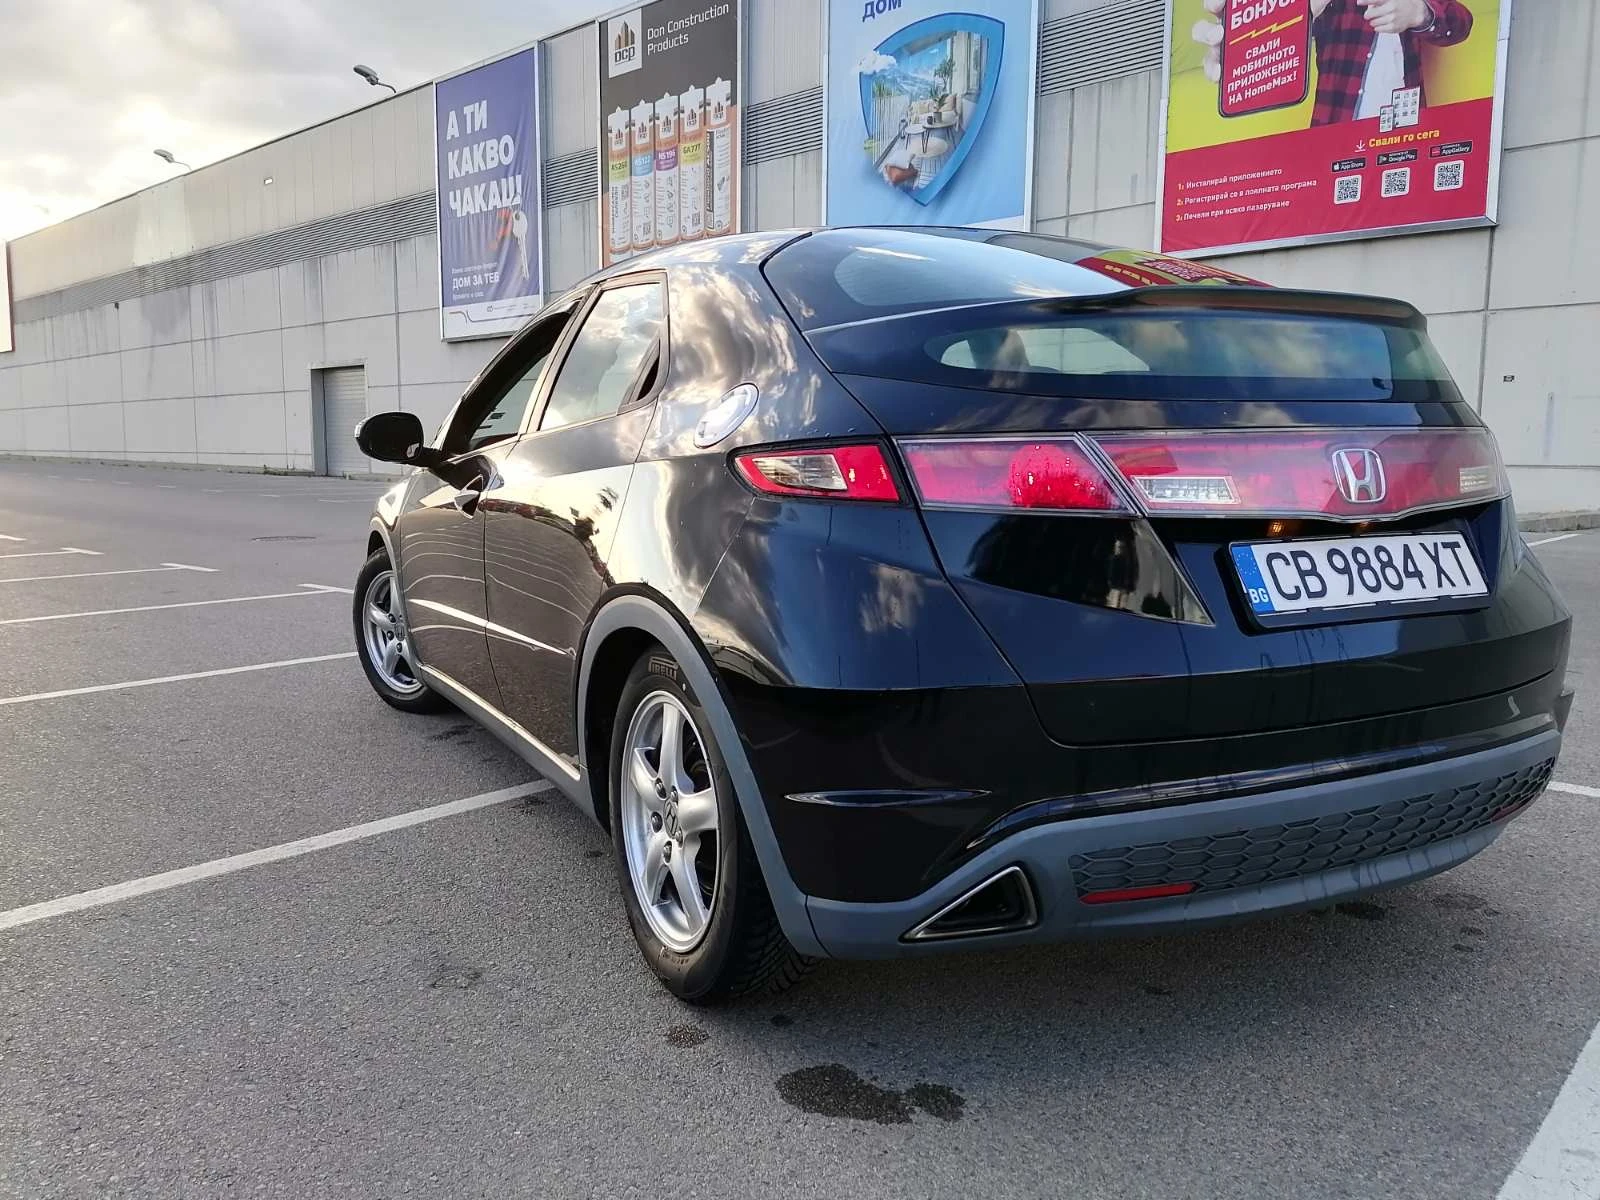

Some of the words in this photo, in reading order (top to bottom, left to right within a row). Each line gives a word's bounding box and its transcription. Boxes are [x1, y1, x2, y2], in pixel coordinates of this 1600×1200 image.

[647, 26, 665, 40] Don
[667, 4, 729, 33] Construction
[1231, 0, 1296, 30] БОНУ
[647, 34, 689, 55] Products
[1245, 37, 1281, 60] СВАЛИ
[1227, 56, 1300, 93] ПРИЛОЖЕНИЕ
[1232, 45, 1296, 78] МОБИЛНОТО
[1228, 92, 1242, 106] НА
[1244, 71, 1297, 100] HomeMax!
[446, 110, 460, 141] А
[464, 100, 488, 135] ТИ
[1368, 136, 1401, 148] Свали
[1402, 134, 1414, 143] го
[1416, 129, 1440, 140] сега
[447, 134, 515, 180] КАКВО
[453, 277, 471, 291] ДОМ
[473, 274, 483, 286] ЗА
[1266, 550, 1327, 600] CB
[1327, 544, 1426, 595] 9884
[1419, 541, 1471, 588] XT
[1248, 588, 1268, 604] BG
